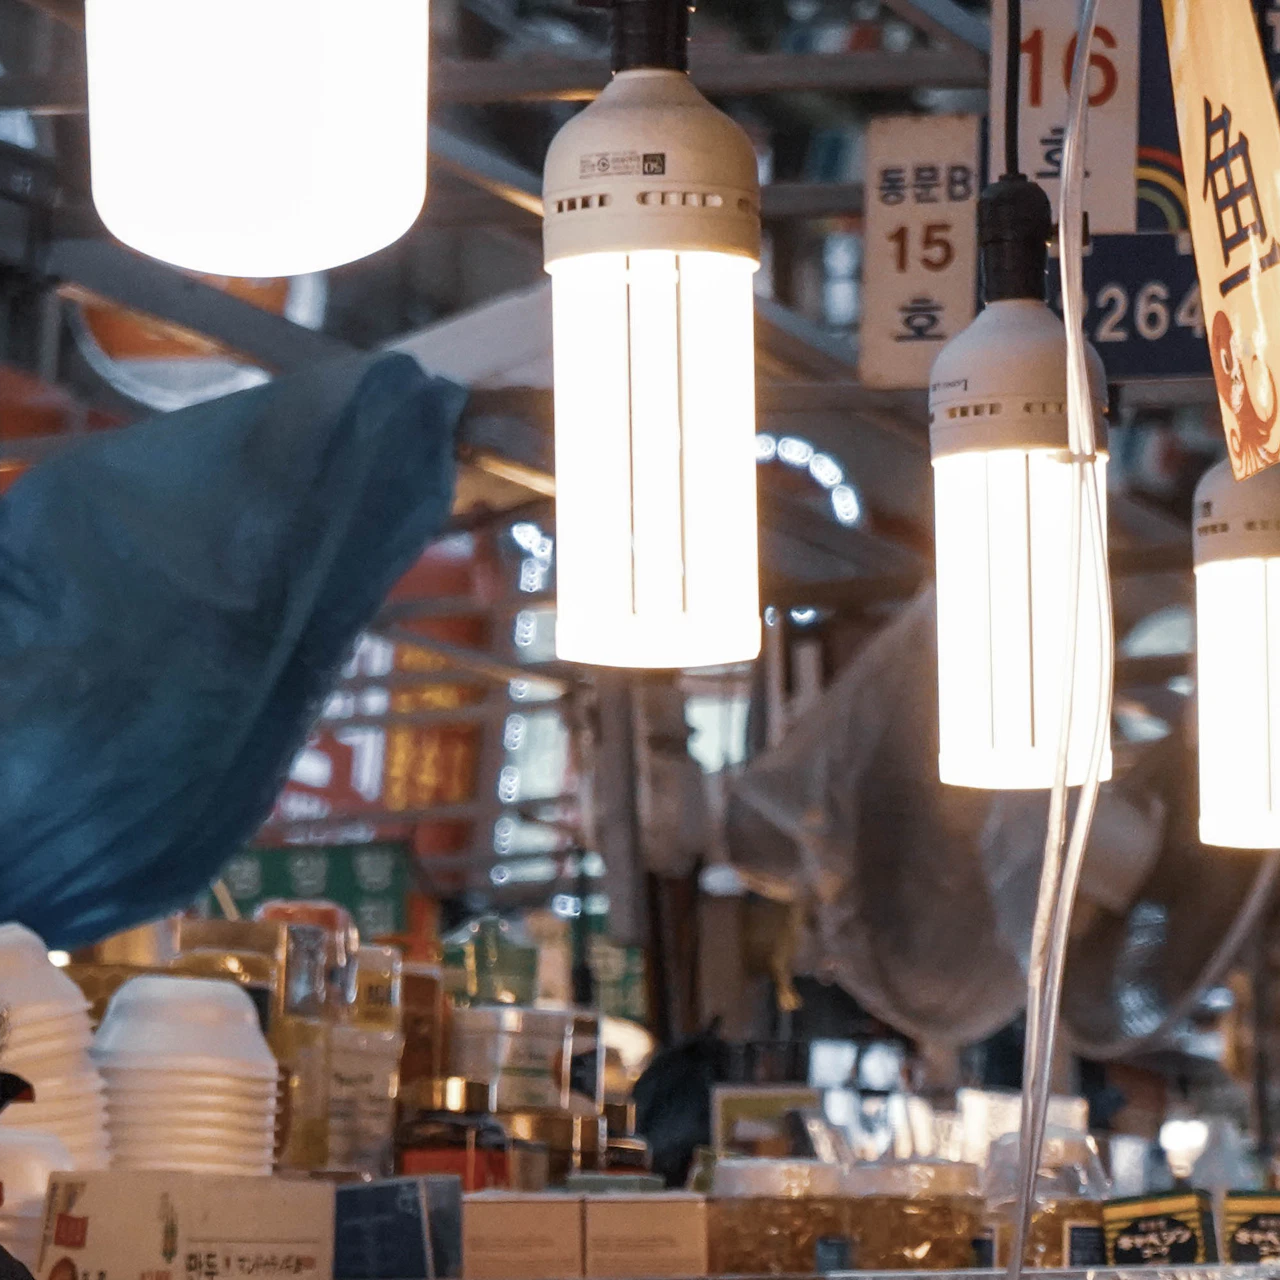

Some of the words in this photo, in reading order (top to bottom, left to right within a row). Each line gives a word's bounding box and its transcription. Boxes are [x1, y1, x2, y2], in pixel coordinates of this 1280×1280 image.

[1021, 25, 1117, 107] 16
[878, 163, 972, 205] 동문B
[885, 218, 956, 274] 15
[893, 297, 948, 343] 호
